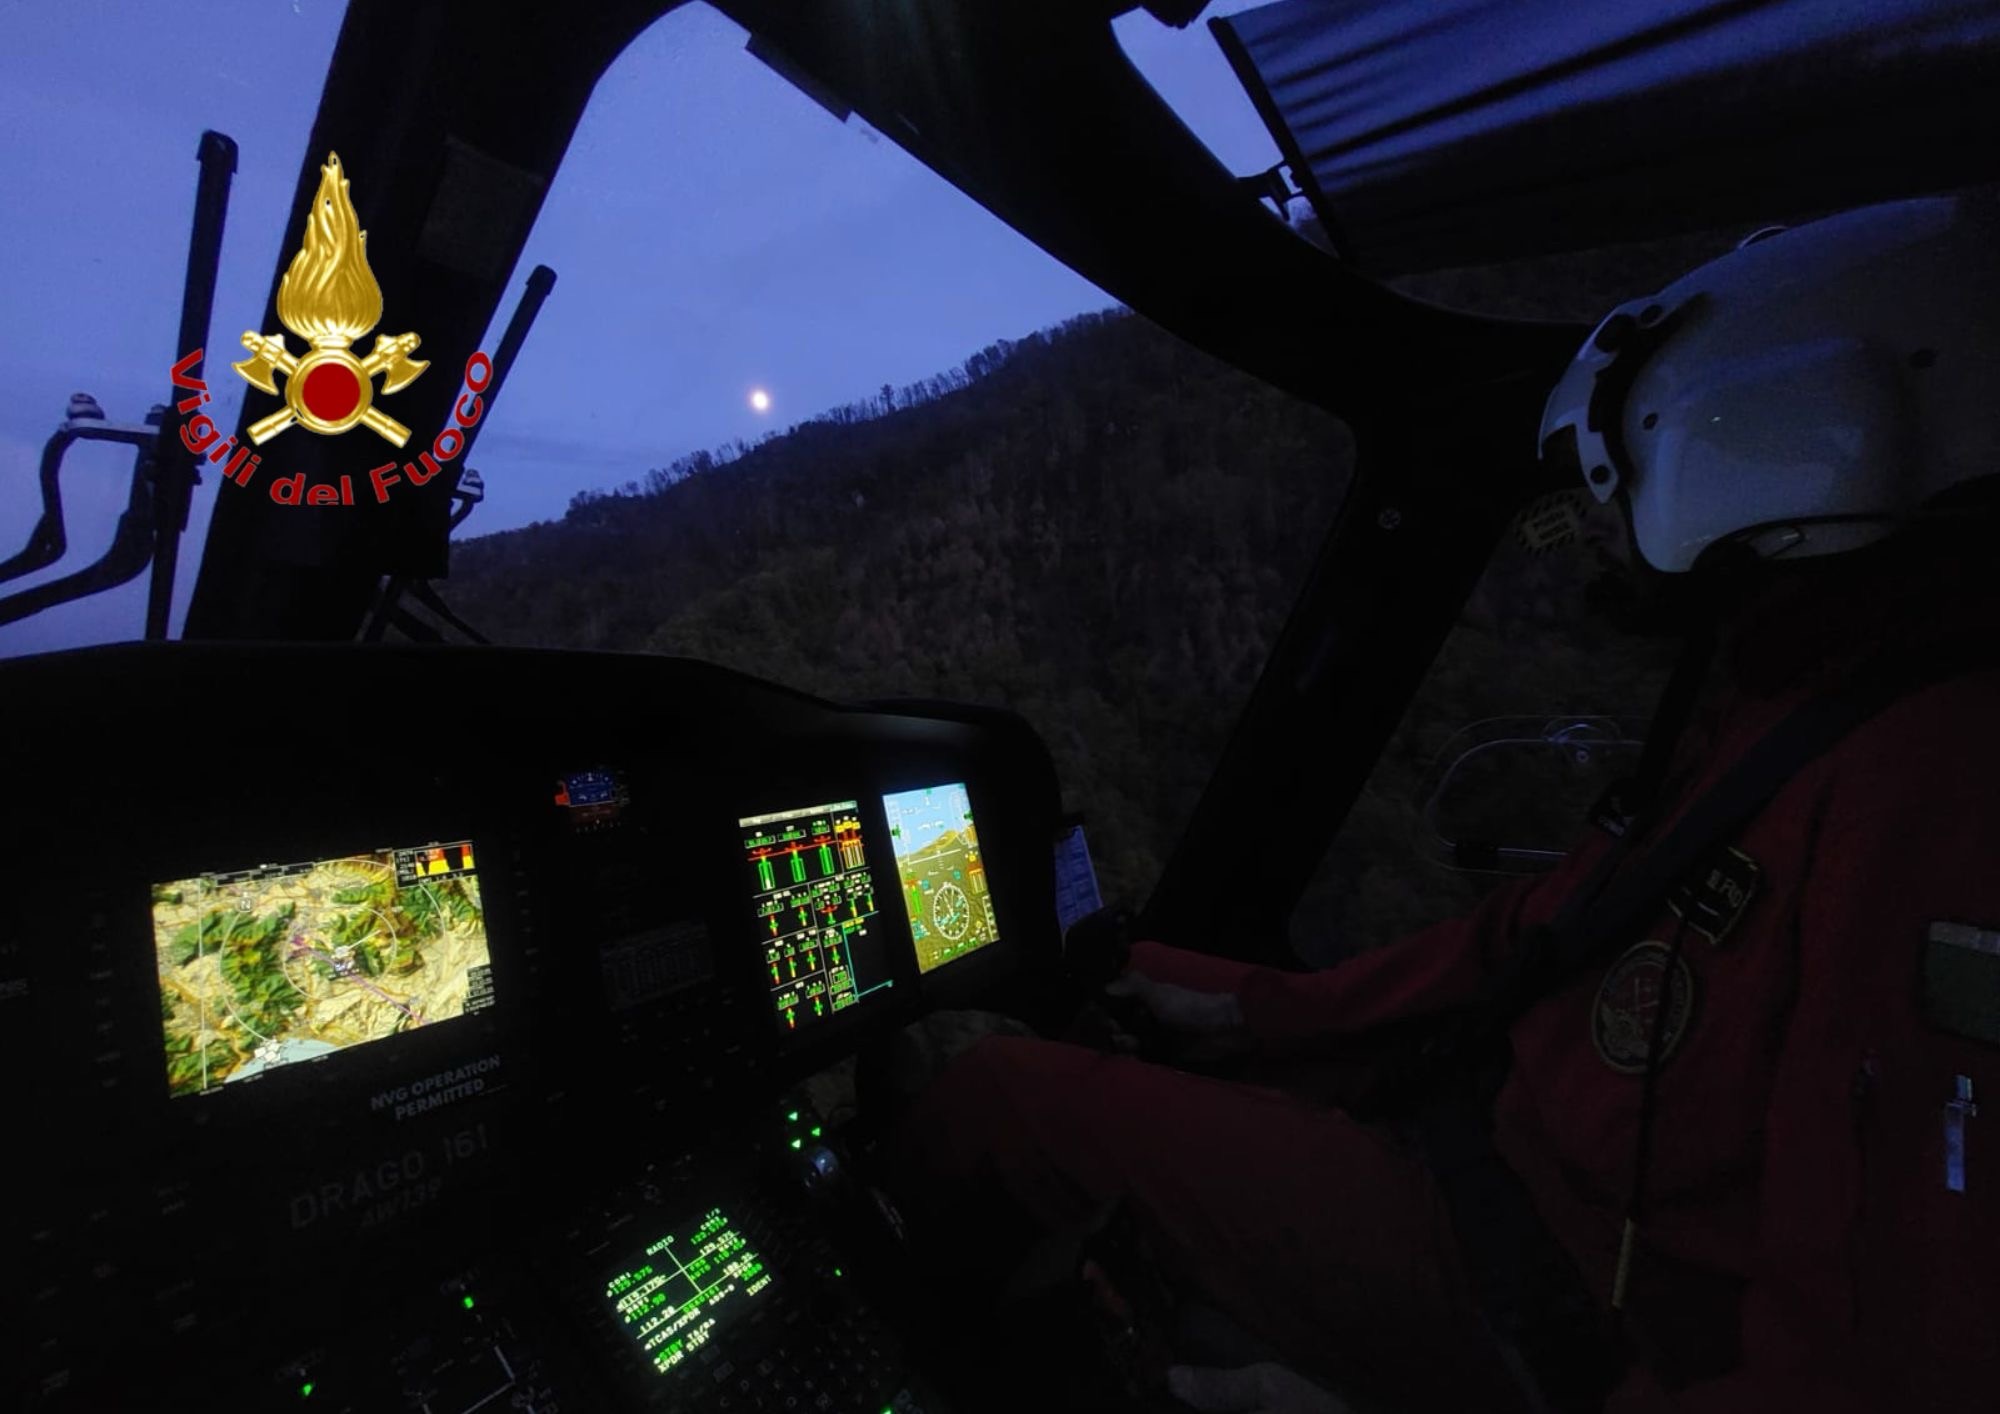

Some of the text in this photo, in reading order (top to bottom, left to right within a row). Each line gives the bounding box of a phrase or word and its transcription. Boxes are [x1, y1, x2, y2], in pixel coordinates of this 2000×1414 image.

[371, 1053, 502, 1112] NVG OPERATION
[394, 1078, 485, 1121] PERMITTED
[288, 1121, 489, 1231] DRAGO 161
[646, 1235, 674, 1256] RADIO
[746, 1273, 772, 1297] IDENT
[648, 1306, 701, 1347] TCAS/XPDR
[658, 1350, 684, 1374] XPDR
